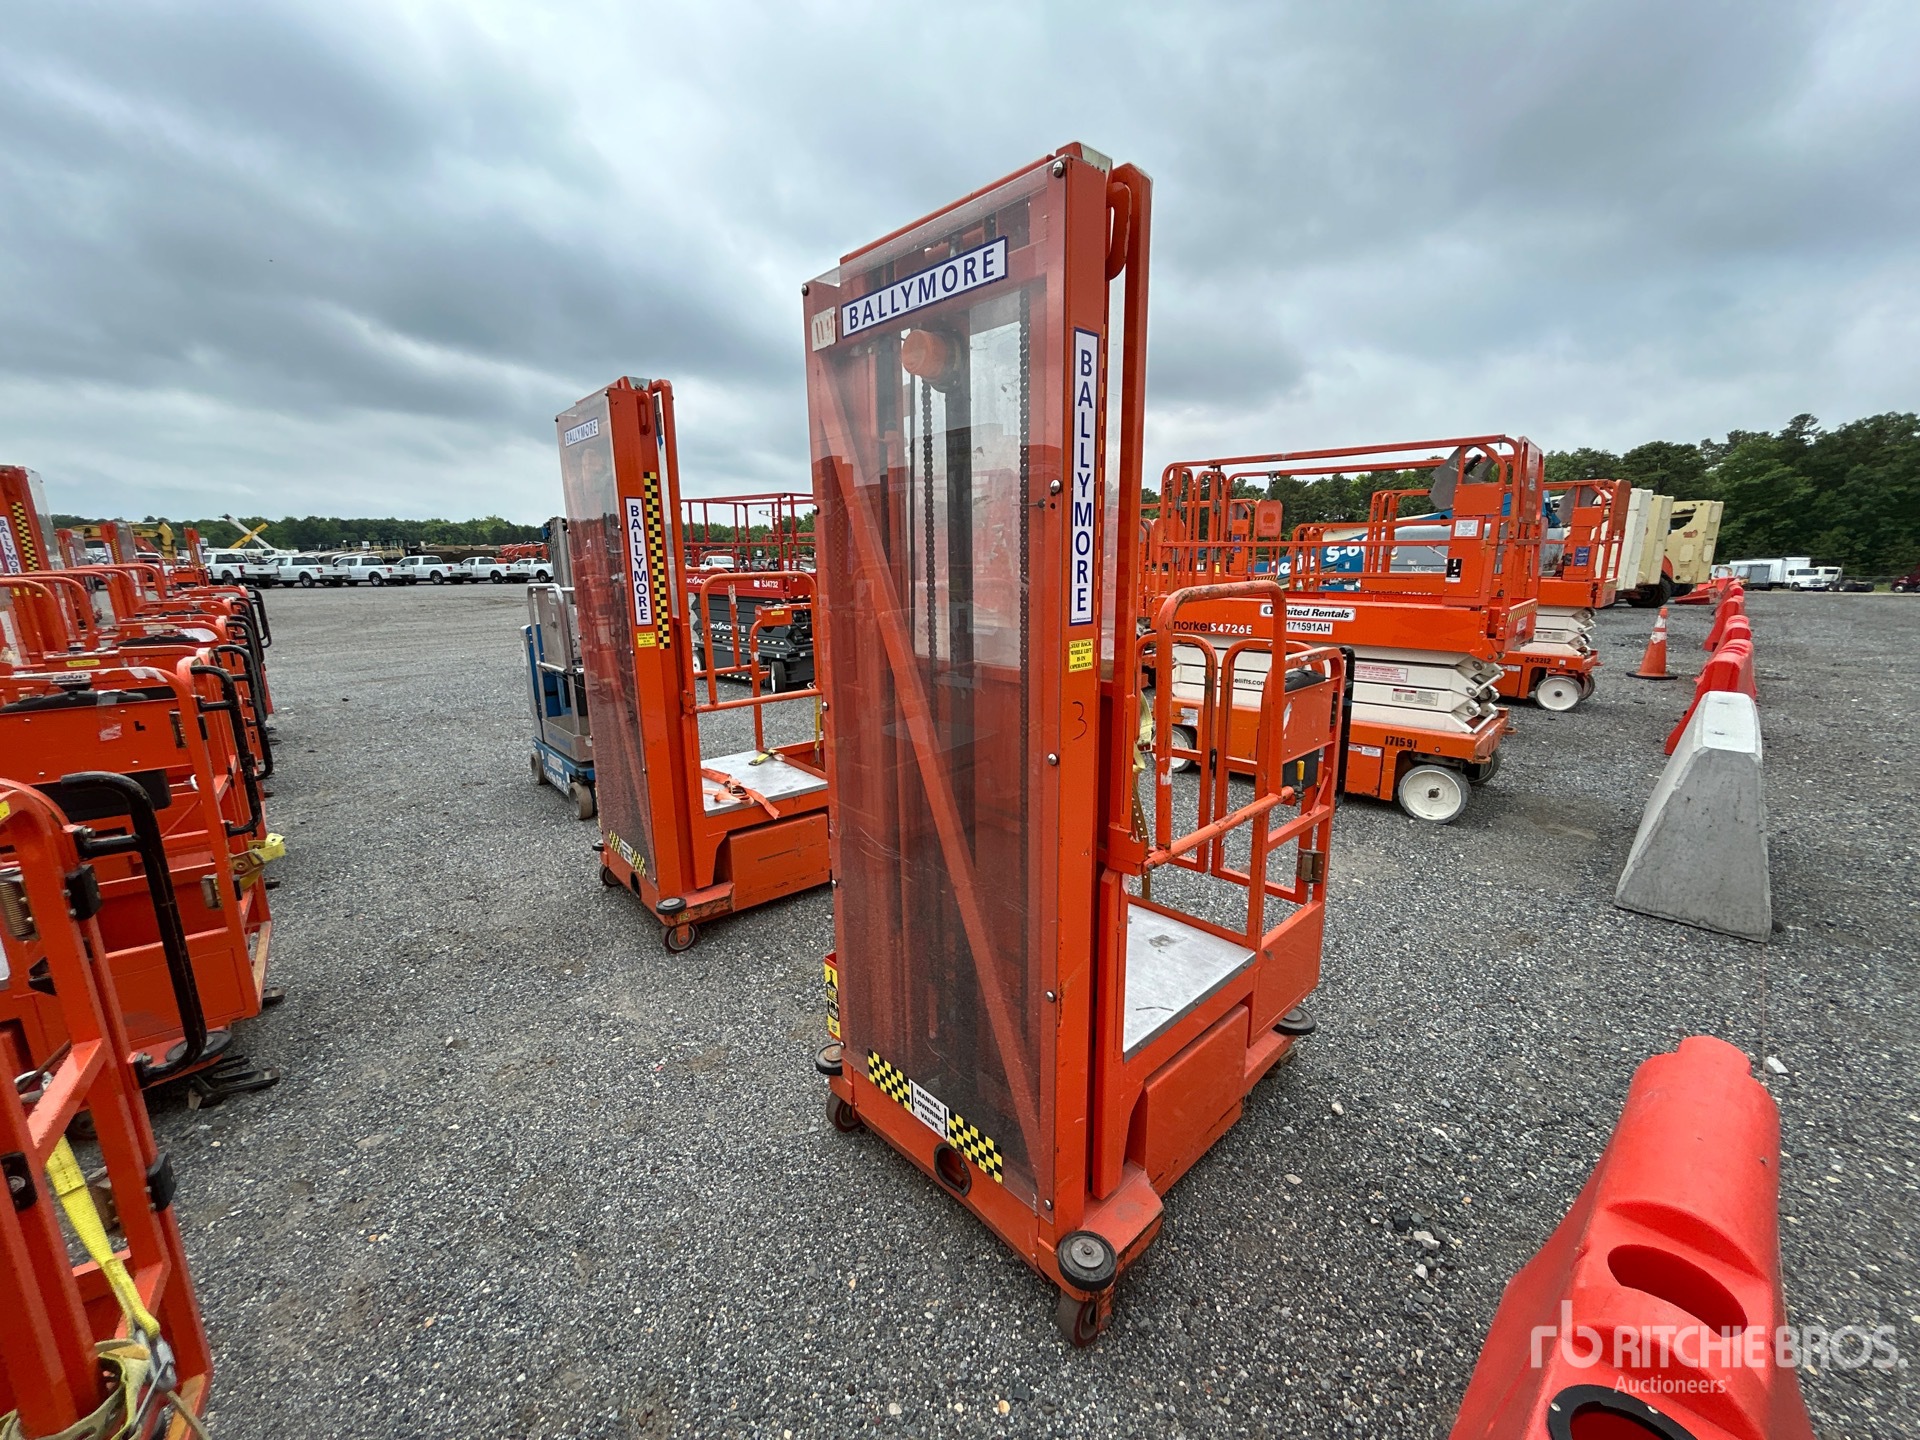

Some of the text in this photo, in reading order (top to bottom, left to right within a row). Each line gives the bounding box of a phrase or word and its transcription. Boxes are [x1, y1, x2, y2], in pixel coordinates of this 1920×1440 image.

[849, 247, 995, 330] BALLYMORE
[566, 420, 597, 445] BALLYMORE
[1074, 349, 1093, 612] BALLYMORE
[0, 520, 19, 573] BALLYMOR
[630, 505, 647, 620] BALLYMORE
[761, 580, 778, 588] SJ4732
[1286, 607, 1350, 619] nited Rentals
[1173, 621, 1252, 634] norkel S4726E
[1287, 621, 1331, 633] 171591AH
[1385, 735, 1417, 748] 171591
[914, 1097, 944, 1124] LOWERING
[916, 1089, 941, 1112] MANUAL
[920, 1111, 939, 1130] VALVE
